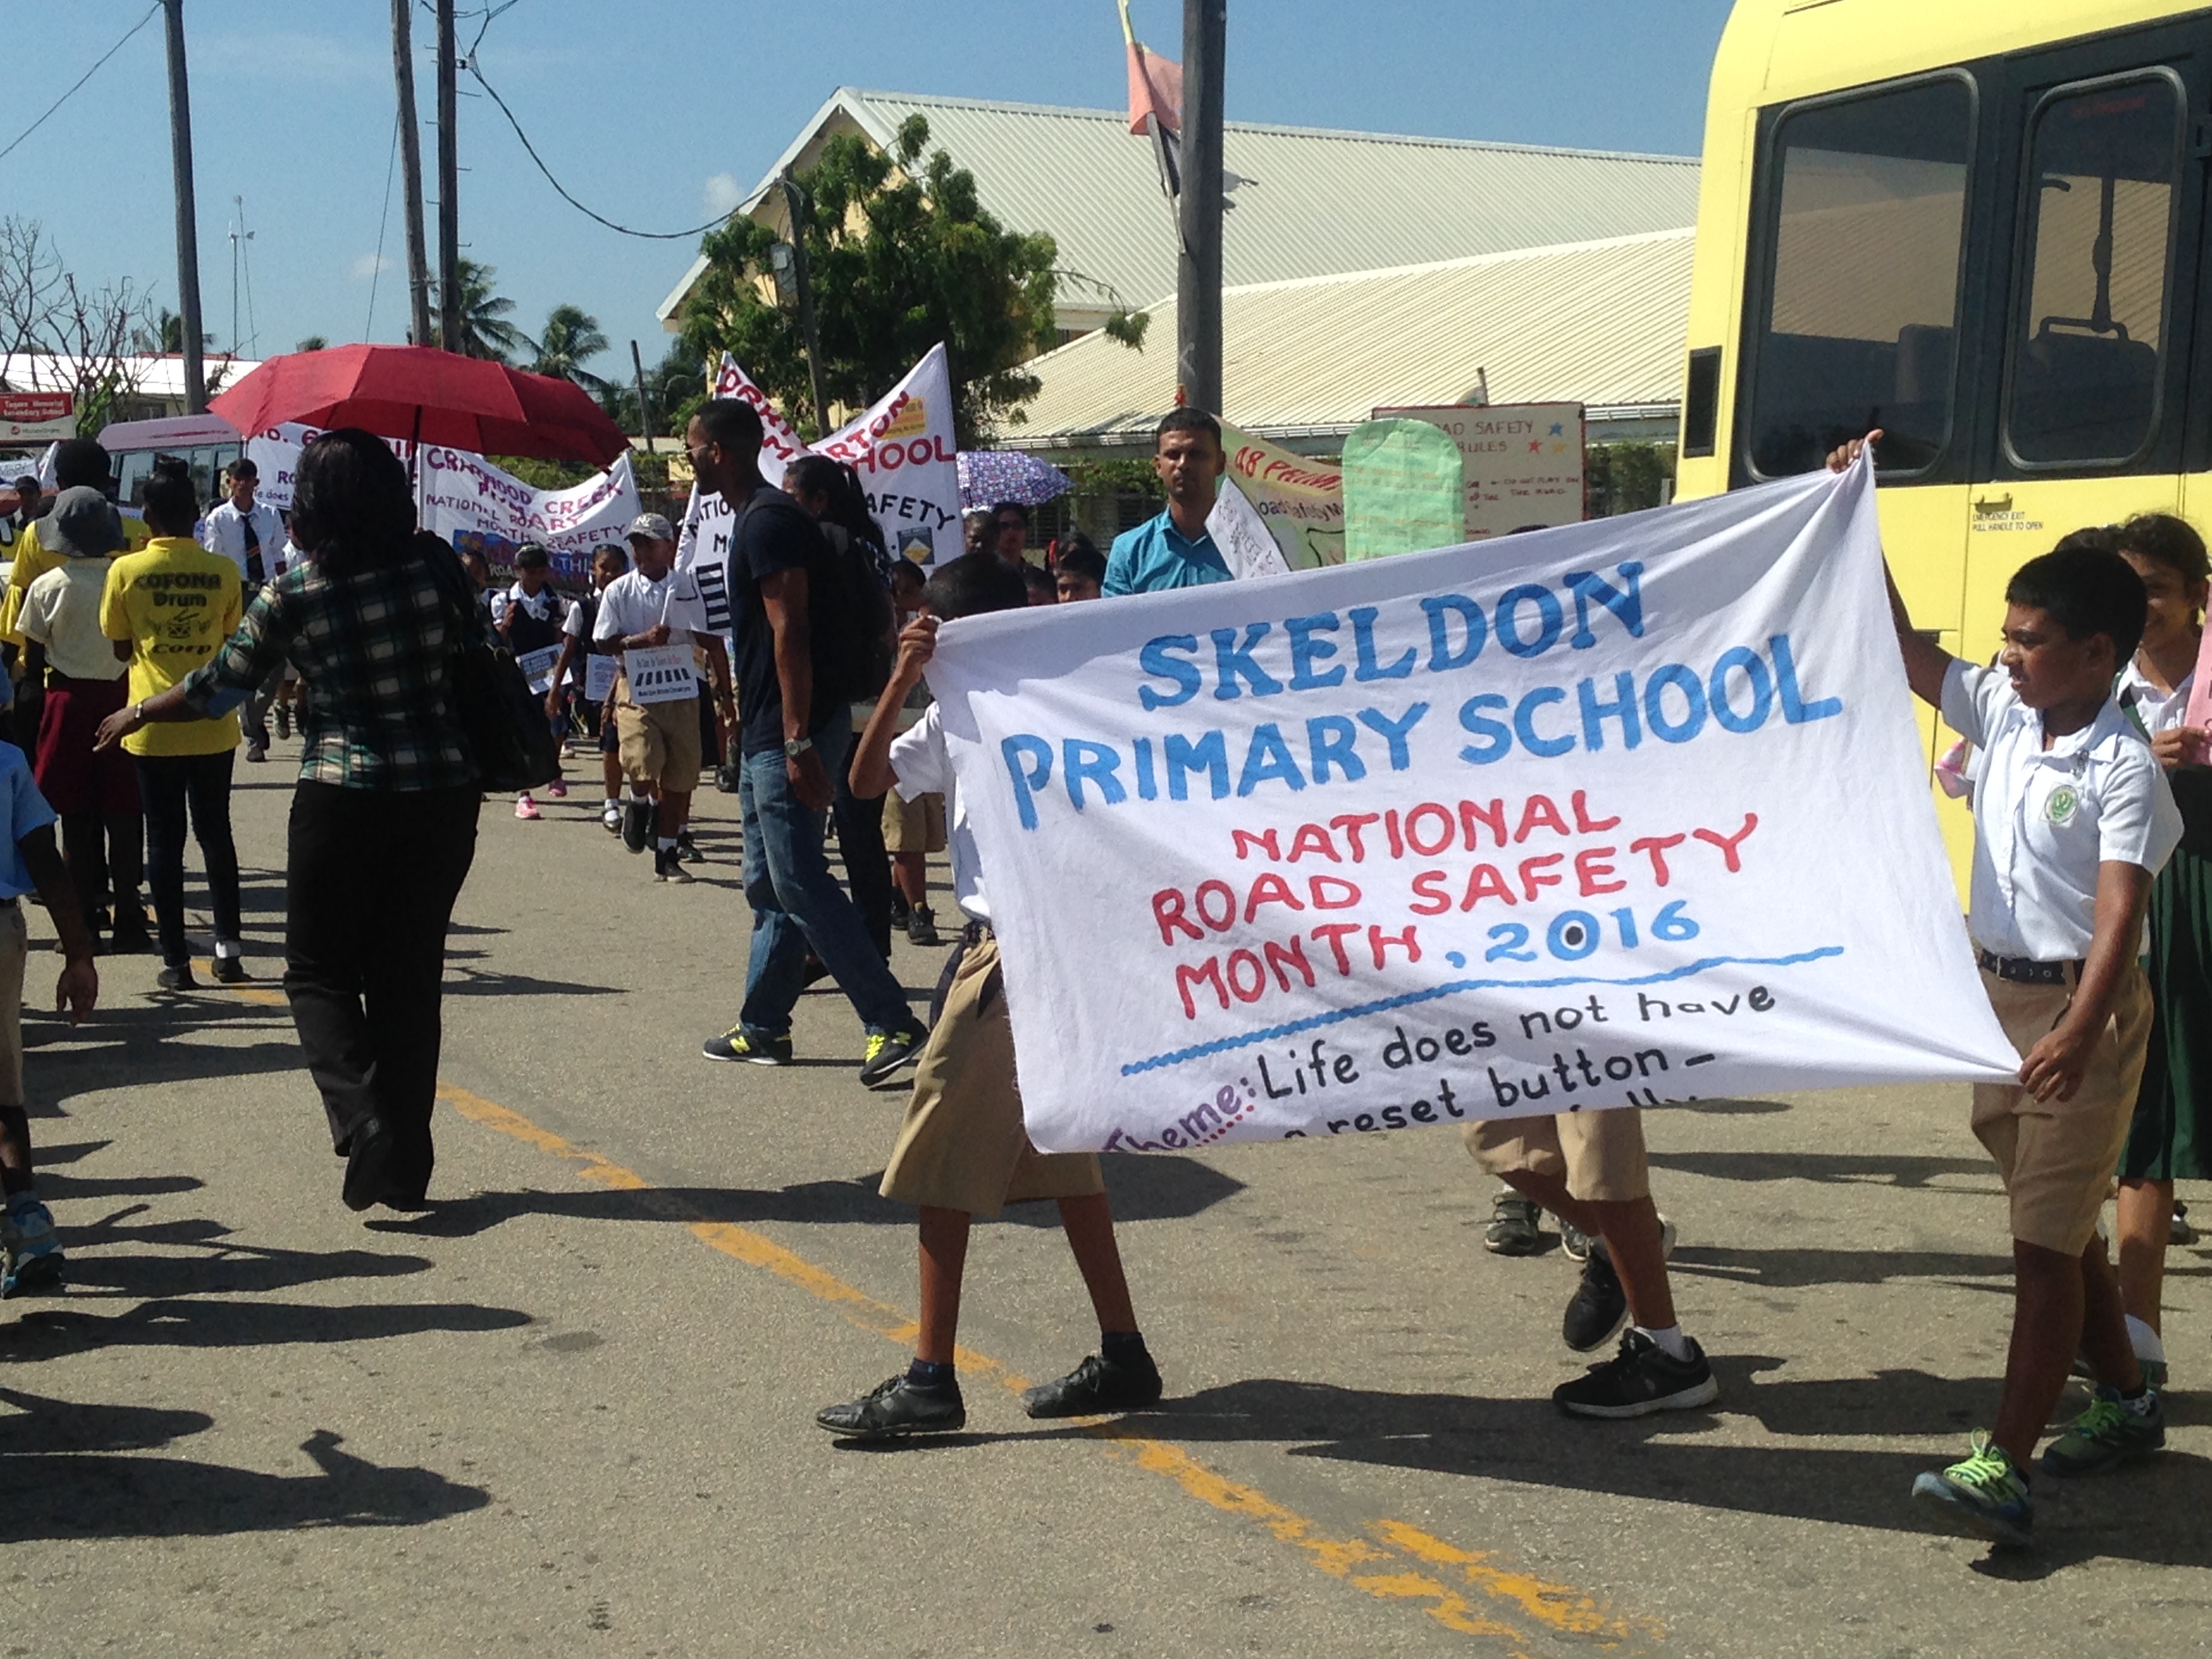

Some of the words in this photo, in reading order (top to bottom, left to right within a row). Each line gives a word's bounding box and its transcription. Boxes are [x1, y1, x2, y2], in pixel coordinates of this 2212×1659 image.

[1476, 420, 1533, 435] SAFETY
[868, 493, 956, 530] AFETY
[153, 592, 207, 607] Drum
[1139, 561, 1645, 712] SKELDON
[1000, 701, 1430, 831] PRIMARY
[1458, 634, 1843, 765] SCHOOL
[1231, 790, 1621, 863] NATIONAL
[1152, 872, 1362, 946] ROAD
[1409, 813, 1758, 916] SAFETY
[1258, 1040, 1359, 1100] Life
[1383, 1021, 1496, 1069] does
[1519, 994, 1609, 1040] not
[1638, 985, 1776, 1022] have
[1327, 1078, 1465, 1138] reset
